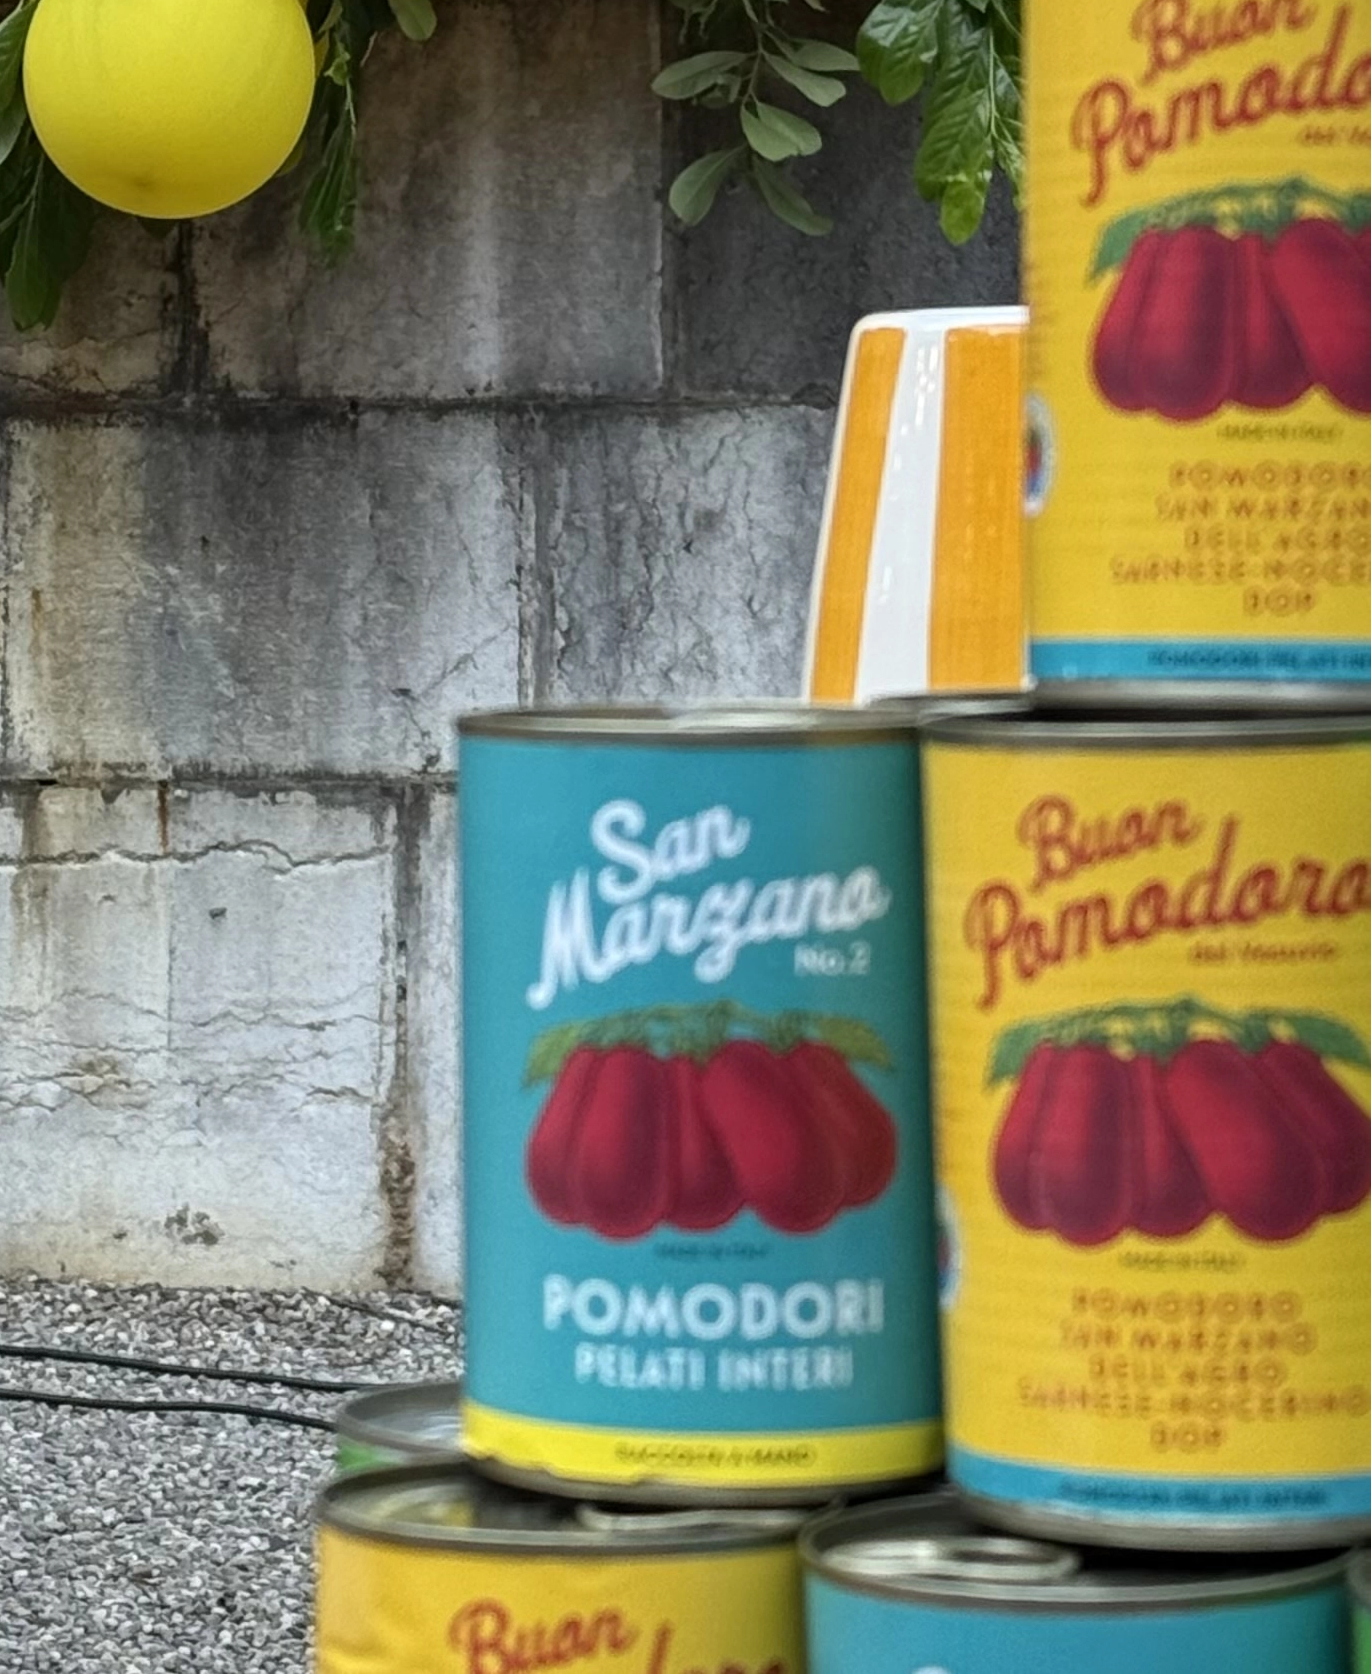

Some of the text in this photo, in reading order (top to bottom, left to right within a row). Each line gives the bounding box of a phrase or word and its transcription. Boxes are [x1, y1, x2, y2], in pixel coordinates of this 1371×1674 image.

[591, 798, 751, 905] San
[526, 865, 892, 1010] Marzano
[963, 811, 1371, 1012] Pomodoro
[542, 1273, 885, 1340] POMODORI
[575, 1341, 855, 1392] PELATI INTERI
